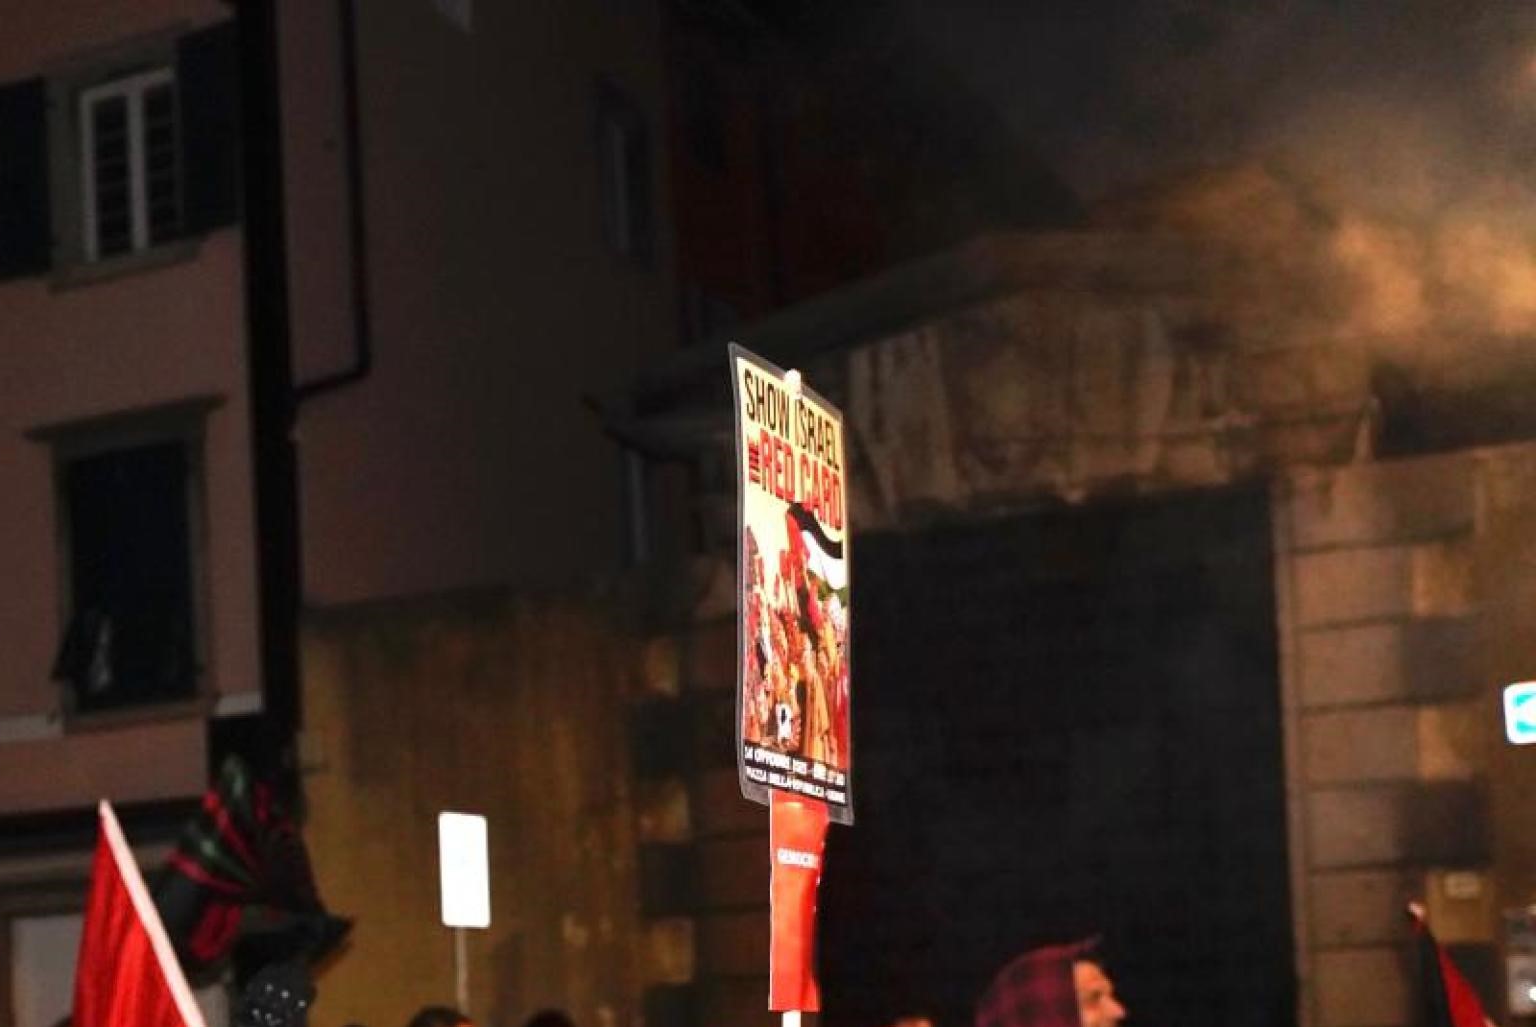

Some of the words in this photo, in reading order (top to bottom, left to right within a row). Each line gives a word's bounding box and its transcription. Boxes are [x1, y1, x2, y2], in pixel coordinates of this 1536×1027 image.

[744, 368, 790, 441] SHOW
[795, 398, 840, 471] ISRAEL
[760, 428, 795, 502] RED
[799, 453, 843, 531] CARD
